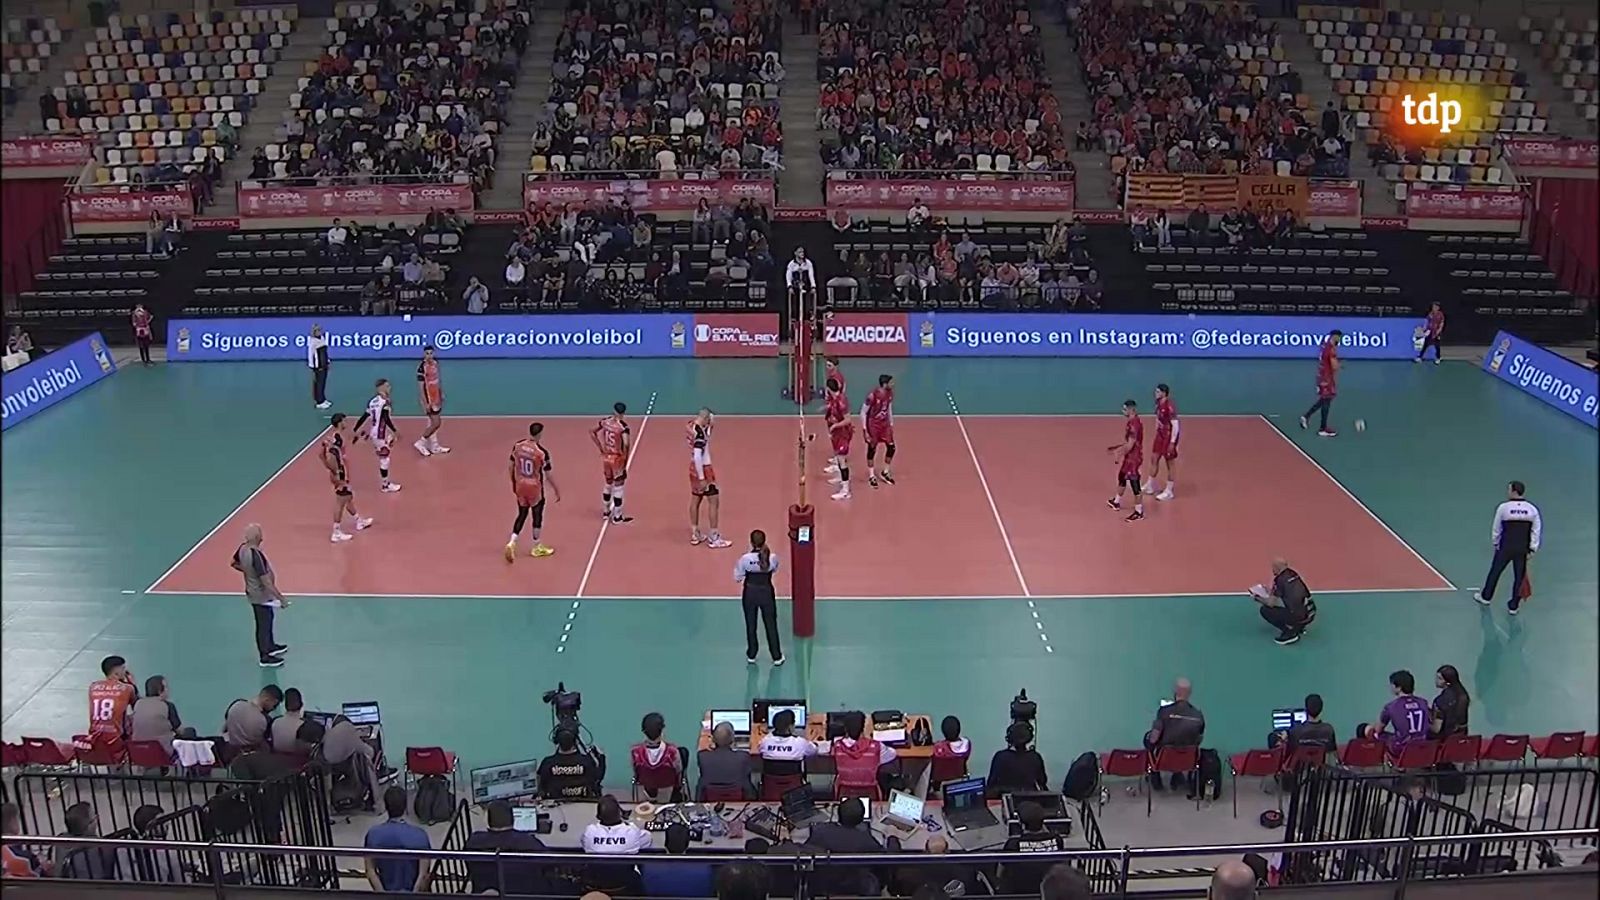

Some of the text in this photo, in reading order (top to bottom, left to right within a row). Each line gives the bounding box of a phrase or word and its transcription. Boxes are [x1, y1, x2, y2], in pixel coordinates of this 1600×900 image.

[271, 192, 300, 200] COPA
[1251, 184, 1296, 196] CELLA
[202, 332, 288, 351] Síguenos
[324, 331, 428, 351] Instagram:
[434, 328, 642, 350] @federacionvoleibol
[824, 325, 906, 343] ZARAGOZA
[947, 327, 1042, 348] Síguenos
[1048, 331, 1072, 344] en
[1080, 328, 1185, 349] Instagram:
[1509, 353, 1582, 405] Síguenos
[518, 454, 533, 477] 10
[92, 698, 114, 721] 18
[1406, 710, 1423, 733] 17
[593, 837, 626, 845] RFEVB
